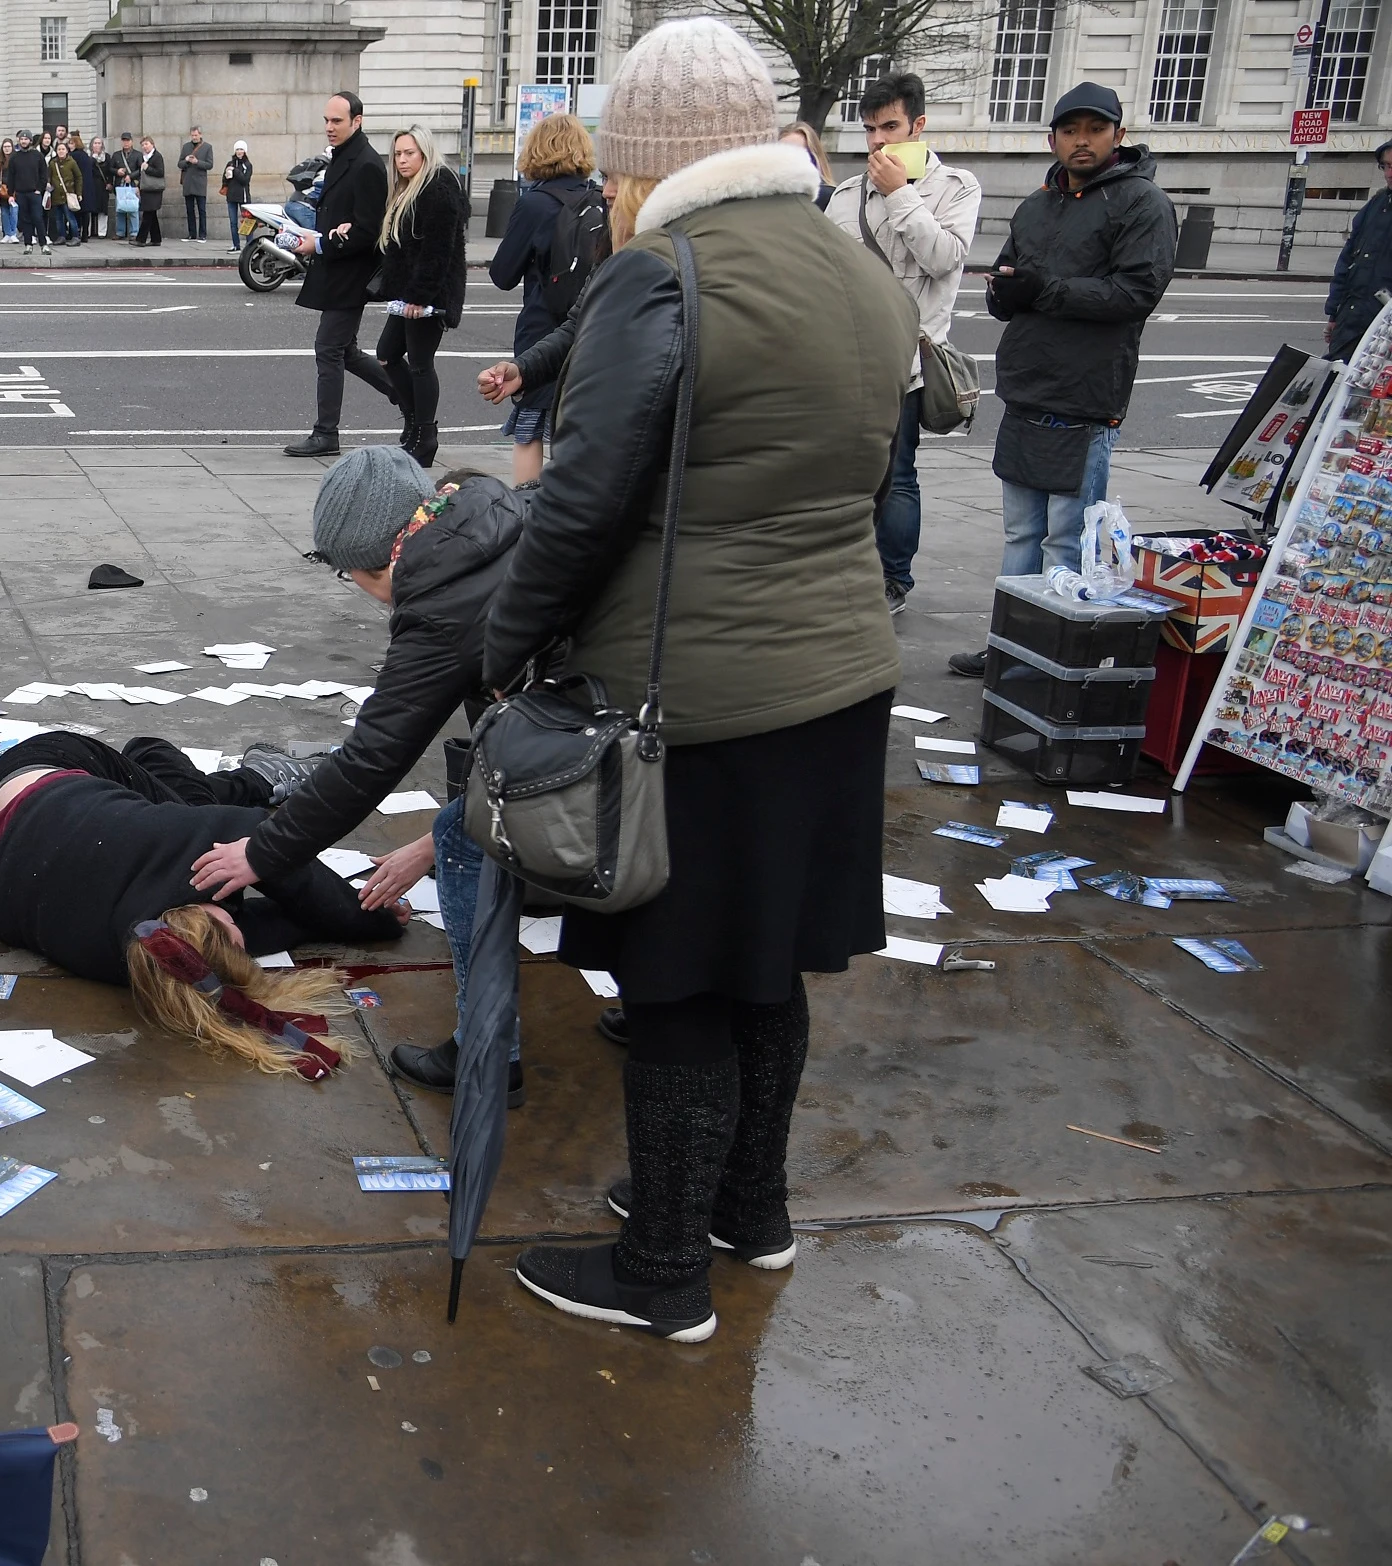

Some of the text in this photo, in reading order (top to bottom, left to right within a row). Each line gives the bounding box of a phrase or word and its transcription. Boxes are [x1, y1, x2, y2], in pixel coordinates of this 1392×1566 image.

[1301, 112, 1322, 120] NEW
[1298, 119, 1323, 127] ROAD
[1294, 127, 1326, 135] LAYOUT
[927, 133, 987, 151] HOME
[1001, 133, 1028, 150] OF
[1147, 132, 1288, 151] GOVERNMEN
[1324, 132, 1372, 149] ROM
[1294, 134, 1323, 142] AHEAD
